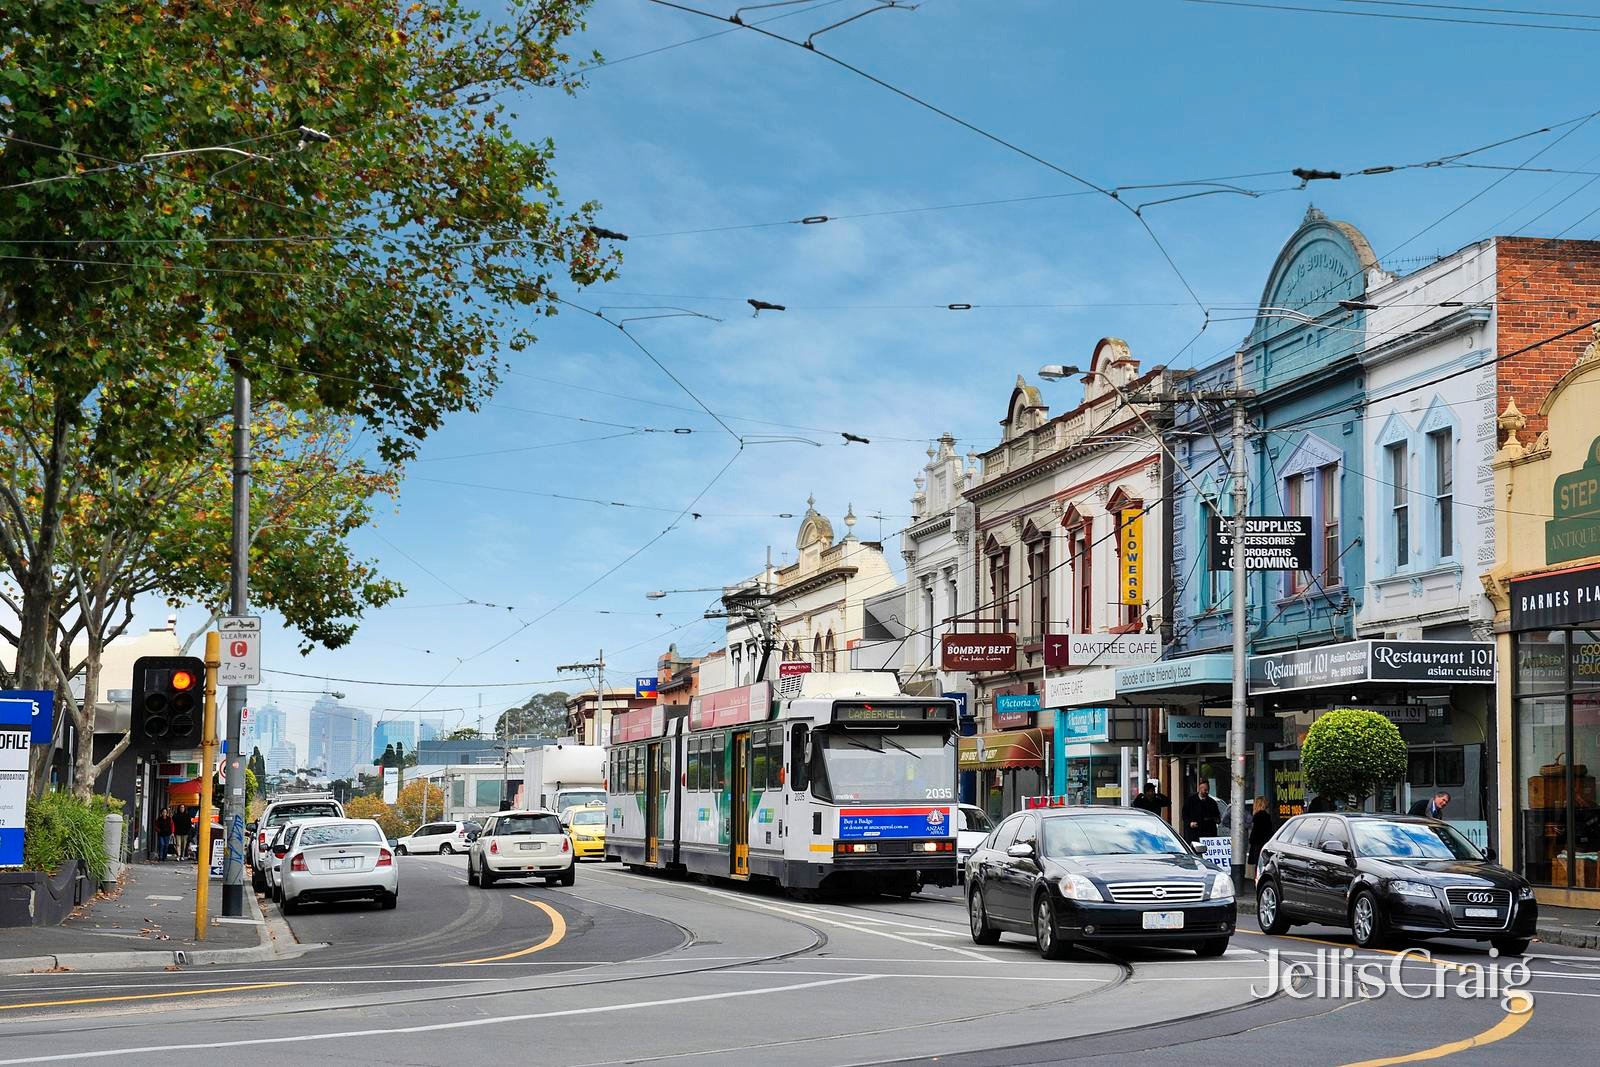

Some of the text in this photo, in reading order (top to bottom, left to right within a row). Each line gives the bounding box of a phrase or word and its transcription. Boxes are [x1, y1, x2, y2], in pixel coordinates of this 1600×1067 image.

[1561, 479, 1598, 511] STEP
[1246, 520, 1301, 532] SUPPLIES
[1219, 536, 1228, 545] &
[1127, 516, 1138, 599] FLOWERS
[1522, 590, 1569, 611] BARNES
[947, 645, 1012, 655] BOMBAY BEAT
[1073, 640, 1158, 654] OAKTREE CAFÉ
[1375, 646, 1494, 669] Restaurant 101
[1121, 664, 1192, 687] abode of the friendly toad
[1264, 661, 1313, 687] Restaurant
[1315, 653, 1329, 674] 101
[1427, 666, 1493, 678] asian cuisine
[1001, 696, 1031, 708] Victoria
[1405, 707, 1421, 718] 101
[1176, 720, 1201, 729] abode
[925, 788, 952, 799] 2035
